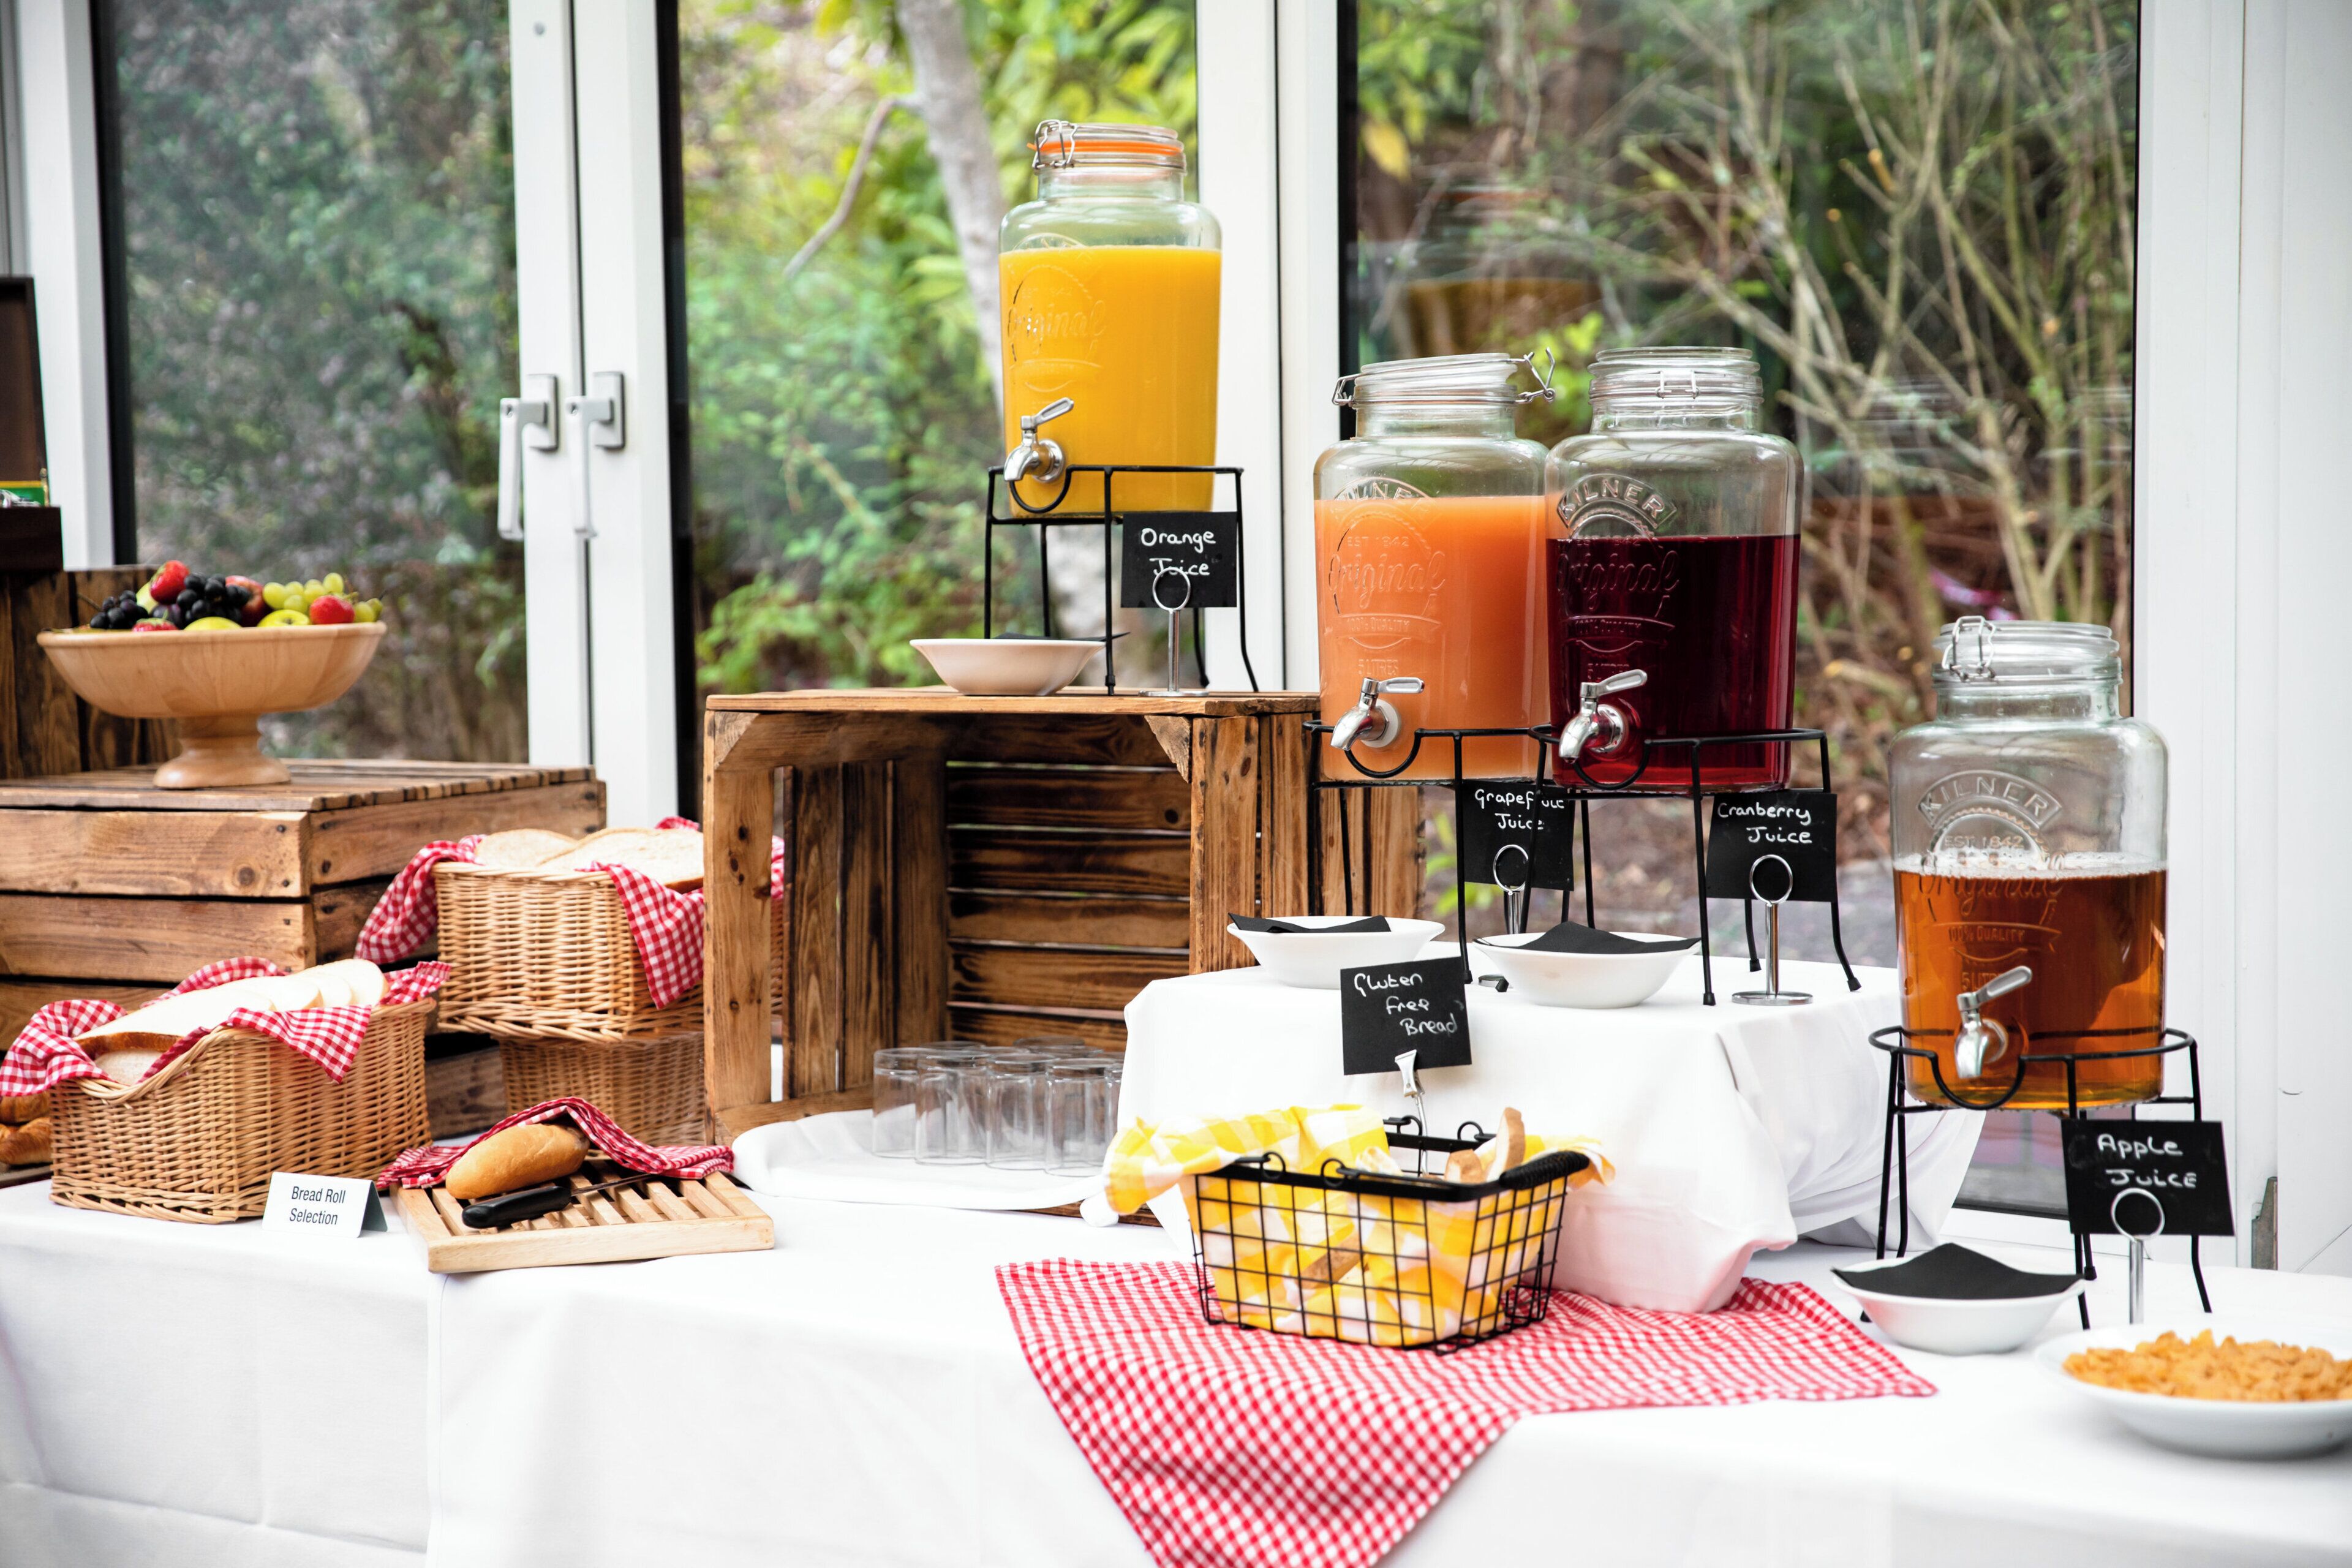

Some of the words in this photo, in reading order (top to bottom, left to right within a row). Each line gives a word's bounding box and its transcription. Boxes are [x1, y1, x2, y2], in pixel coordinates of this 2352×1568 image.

[1562, 478, 1665, 520] KILNER
[1140, 527, 1216, 554] Orange
[1328, 551, 1446, 609] Original
[1556, 550, 1679, 610] Original
[1920, 777, 2049, 817] KILNER
[1717, 802, 1812, 826] Cranberry
[1746, 826, 1813, 843] Juice
[1944, 835, 1975, 849] EST
[1983, 835, 2024, 849] 1842
[1948, 925, 1973, 942] 100%
[1977, 925, 2026, 942] QUALITY
[1354, 973, 1423, 997] Gluten
[1961, 971, 1971, 991] 5
[1399, 1012, 1458, 1037] Bread
[2097, 1133, 2184, 1159] Apple
[291, 1186, 323, 1202] Bread
[325, 1188, 346, 1204] Roll
[289, 1207, 338, 1225] Selection
